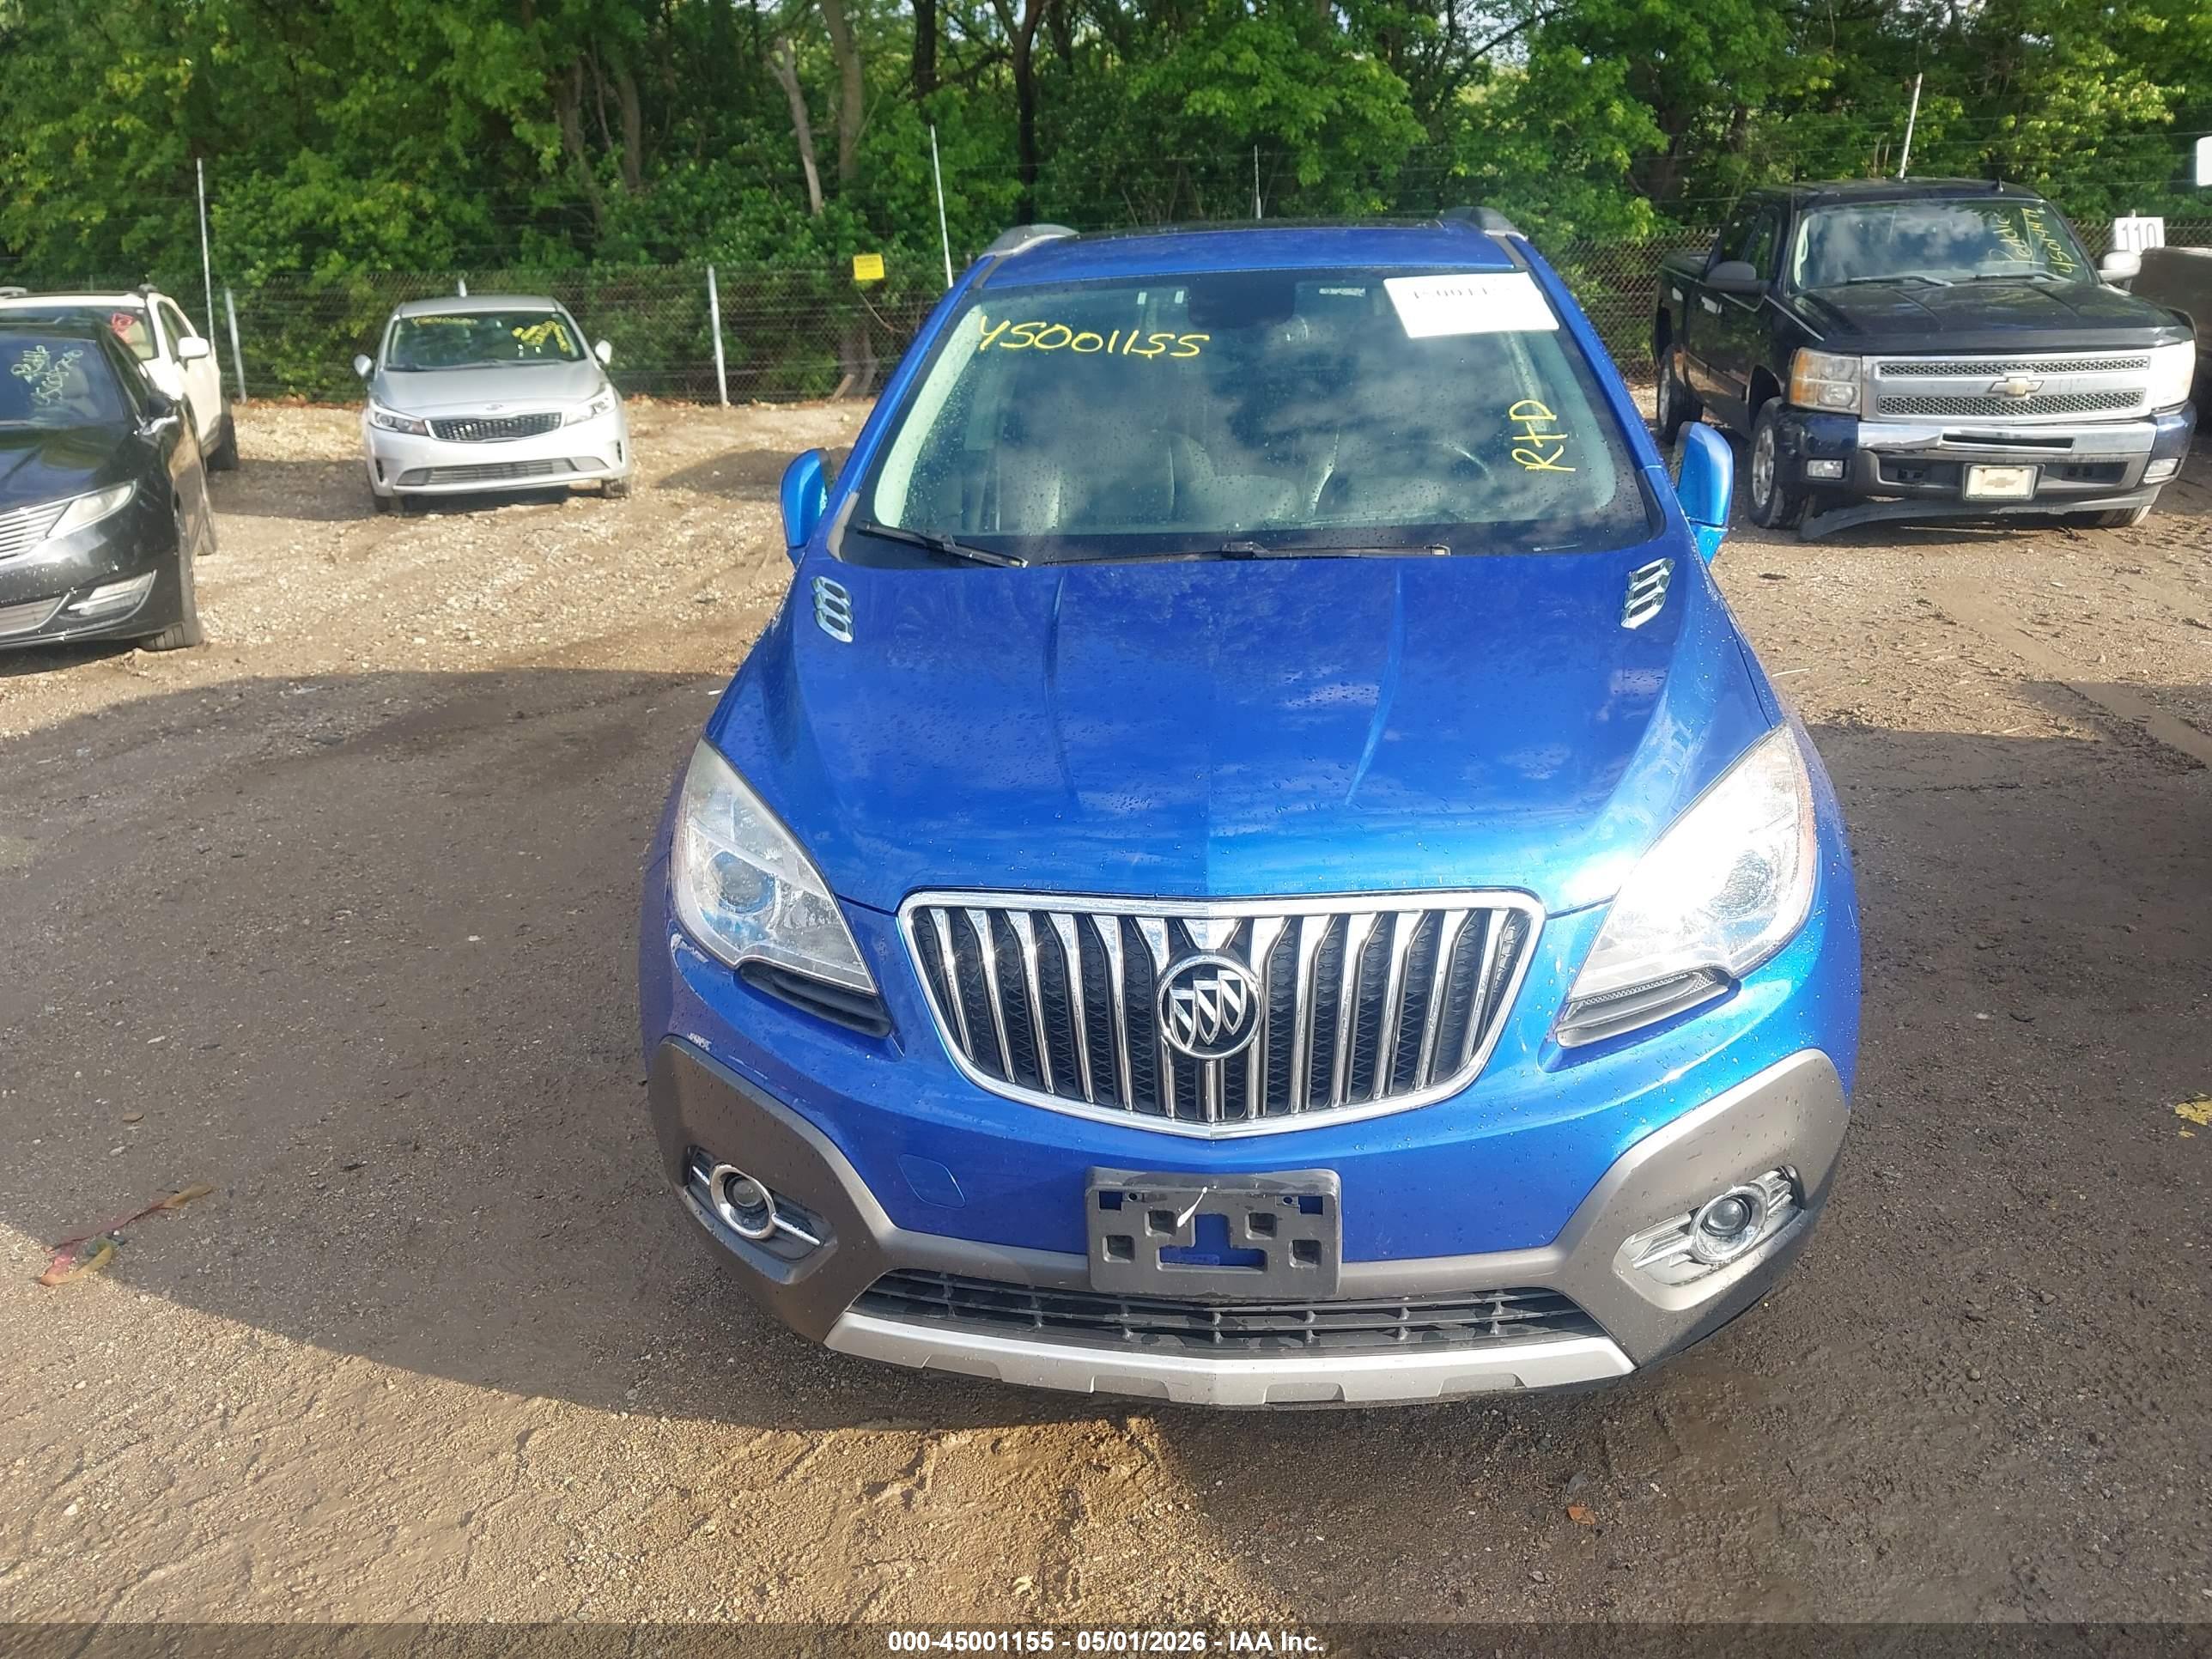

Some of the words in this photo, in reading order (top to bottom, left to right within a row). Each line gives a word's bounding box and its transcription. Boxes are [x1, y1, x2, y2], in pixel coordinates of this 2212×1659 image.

[2122, 222, 2158, 252] 110
[979, 314, 1211, 359] 45001155
[1508, 399, 1577, 473] RHD
